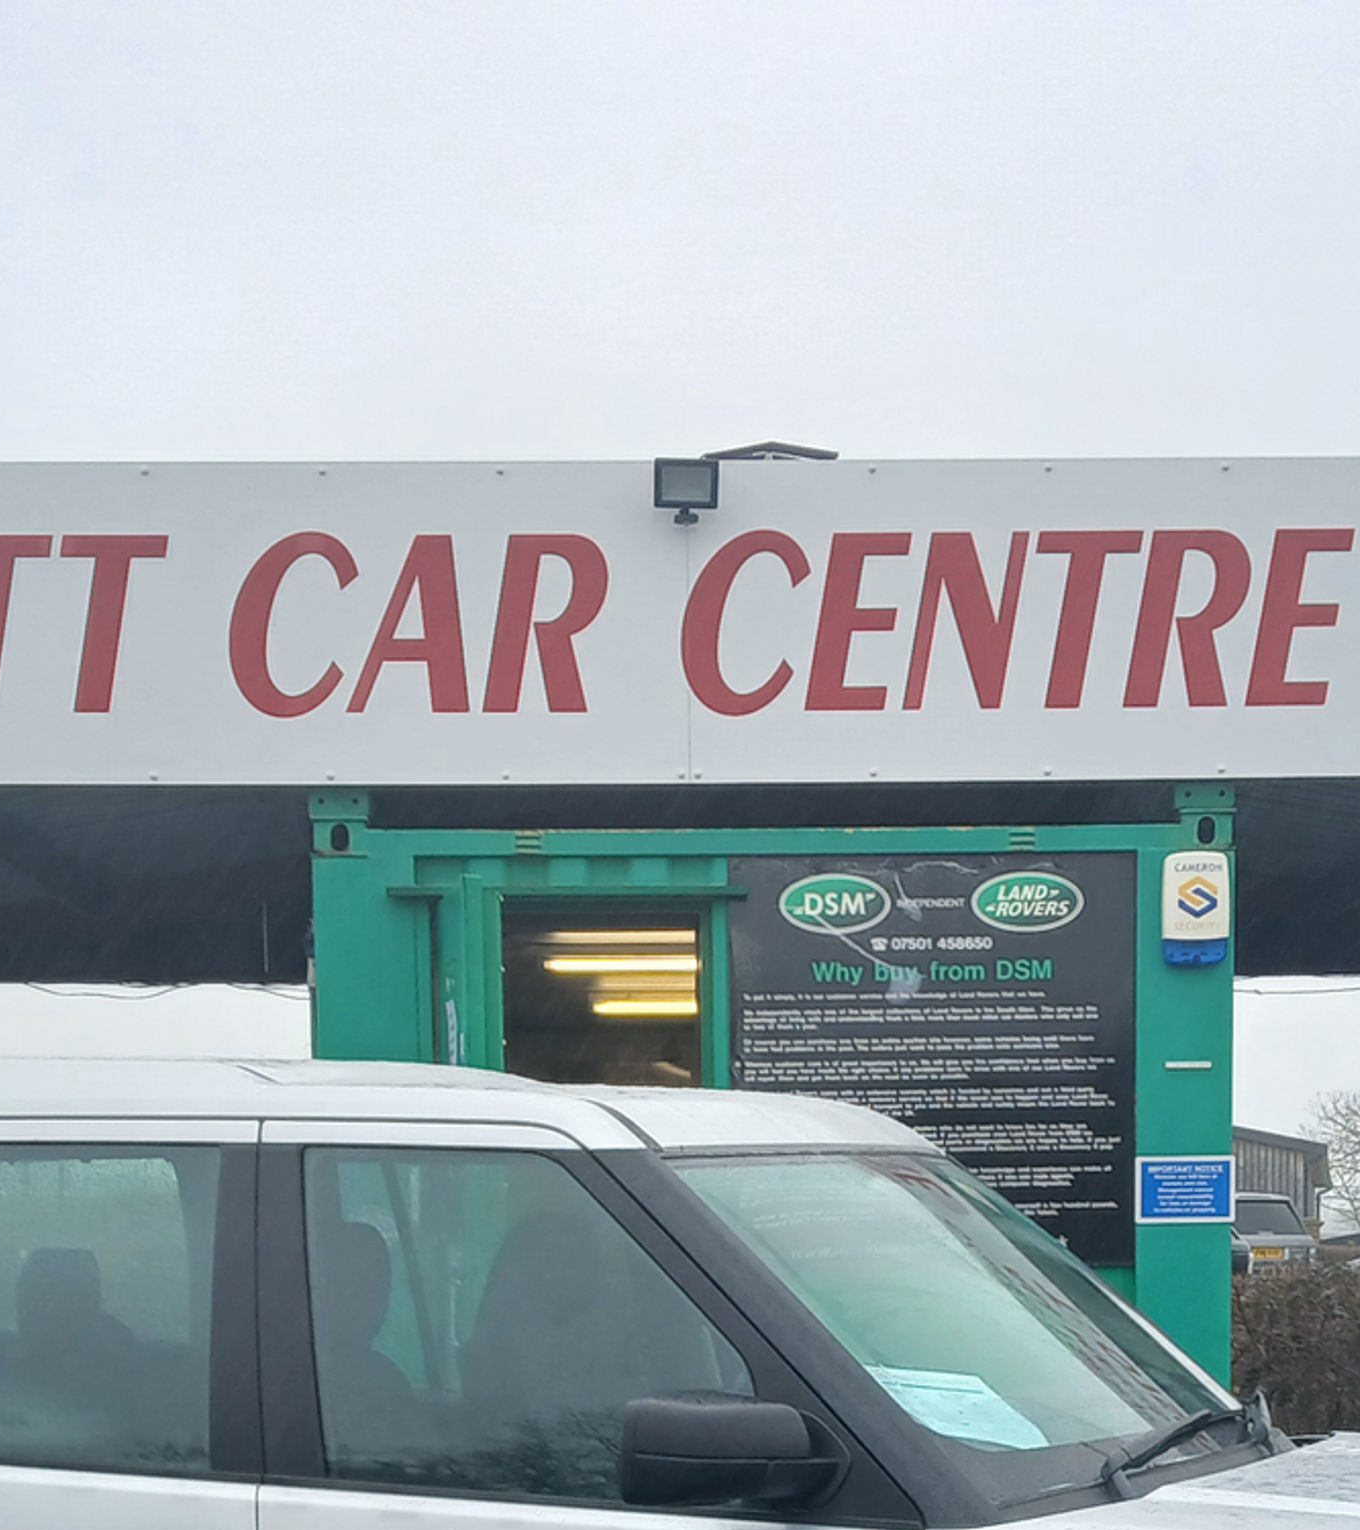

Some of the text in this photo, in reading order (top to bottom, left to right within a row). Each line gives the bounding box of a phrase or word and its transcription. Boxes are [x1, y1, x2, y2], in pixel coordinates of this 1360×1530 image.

[228, 528, 609, 719] CAR
[680, 526, 1356, 718] CENTRE
[1174, 862, 1223, 873] CAMERON
[996, 884, 1050, 900] LAND
[802, 891, 868, 917] DSM
[896, 897, 965, 908] INDEPENDENT
[995, 899, 1070, 918] ROVERS
[1174, 922, 1223, 932] SECURITY
[890, 936, 993, 951] 07501 458650
[811, 960, 1054, 985] Why buy from DSM
[1194, 1164, 1224, 1174] NOTICE
